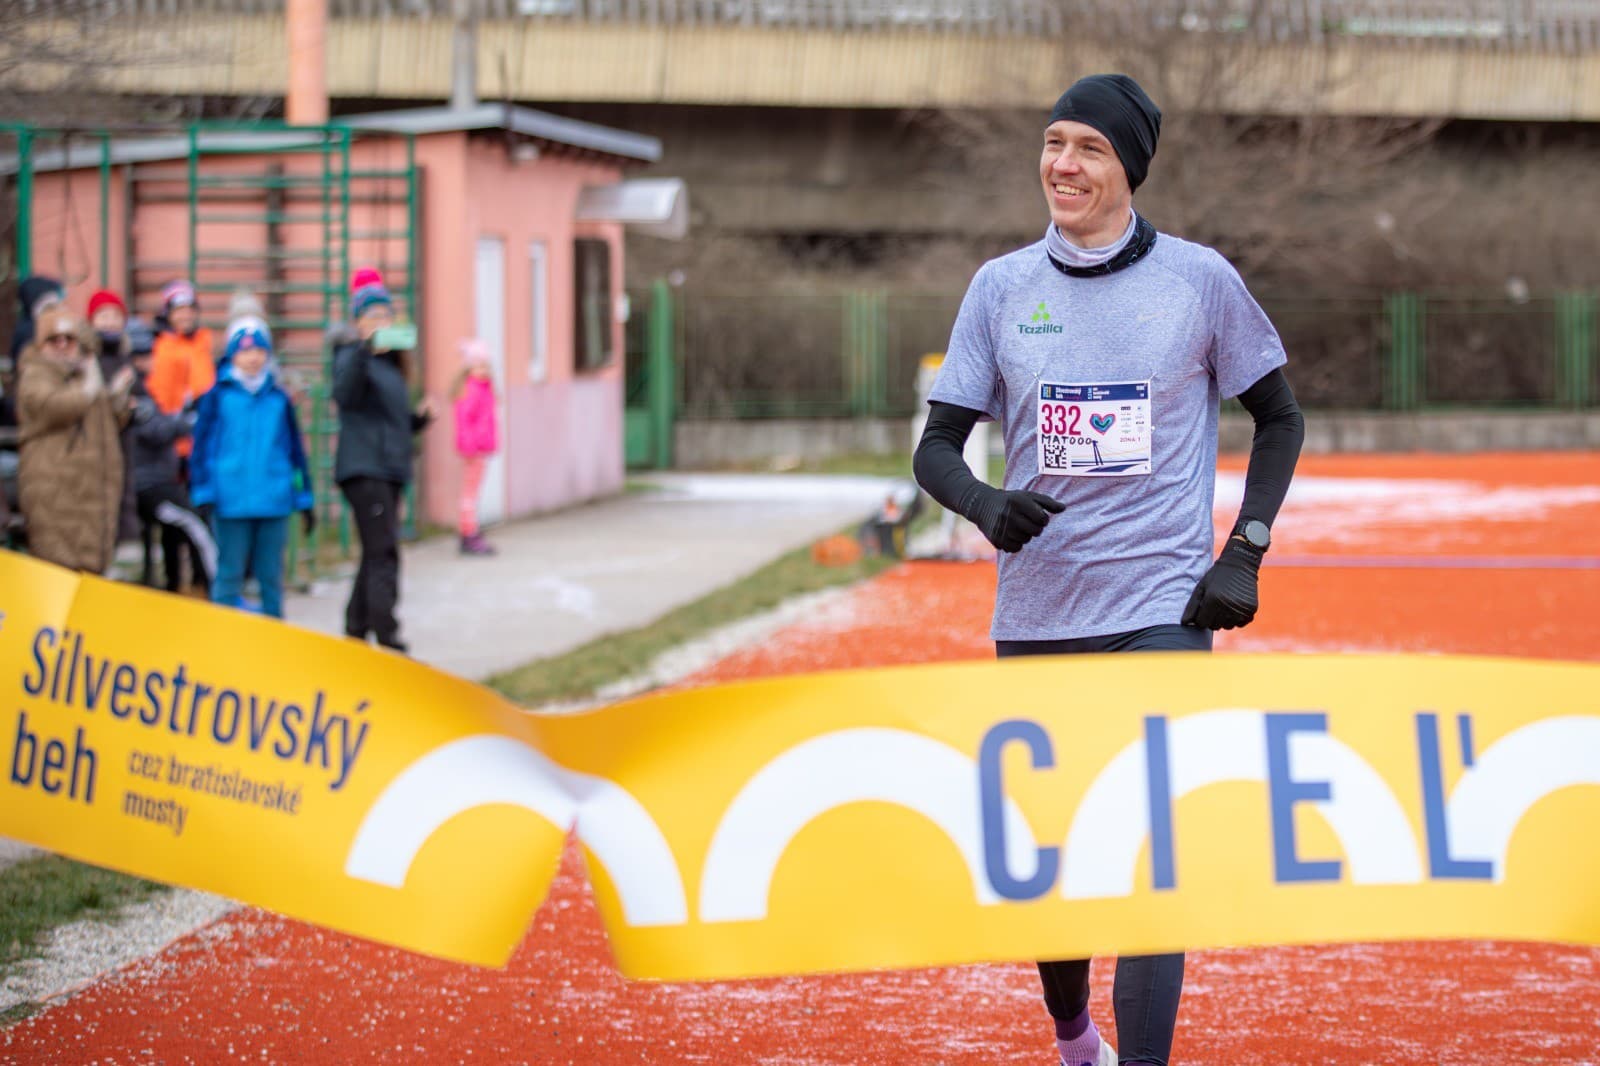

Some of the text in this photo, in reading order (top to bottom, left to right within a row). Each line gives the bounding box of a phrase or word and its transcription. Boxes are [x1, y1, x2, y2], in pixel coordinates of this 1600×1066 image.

[1017, 324, 1063, 335] Tazilla
[1041, 404, 1081, 435] 332
[22, 625, 373, 792] Silvestrovský
[9, 711, 99, 806] beh
[128, 749, 304, 816] cez bratislavské
[123, 790, 190, 837] mosty
